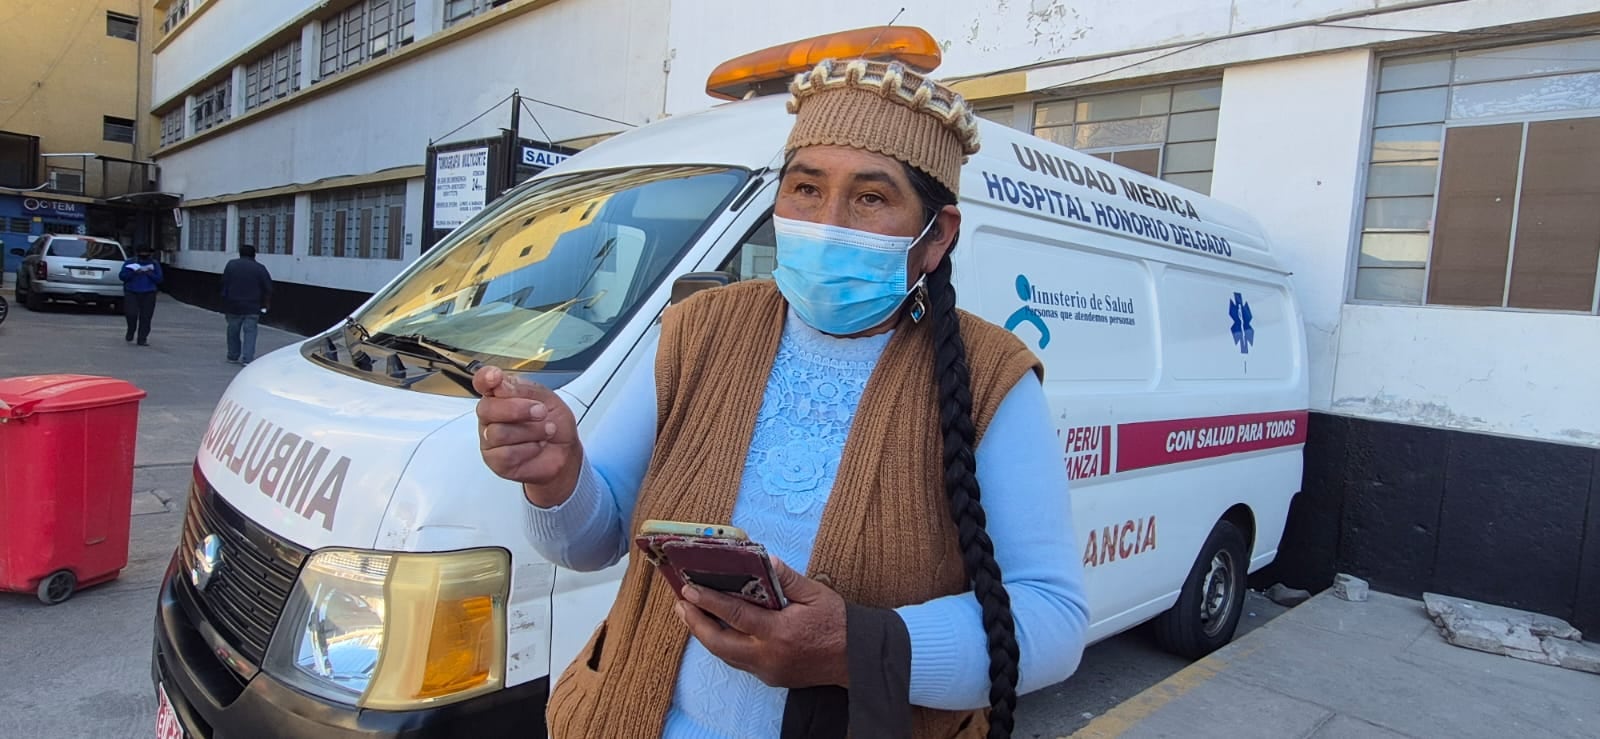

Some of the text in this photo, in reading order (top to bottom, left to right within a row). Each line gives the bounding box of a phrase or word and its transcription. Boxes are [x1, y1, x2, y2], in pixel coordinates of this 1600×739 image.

[1011, 143, 1201, 222] UNIDAD MEDICA
[982, 171, 1232, 257] HOSPITAL HONORIO DELGADO
[1024, 285, 1134, 314] Ministerio de Salud
[1025, 305, 1136, 326] Personas que atendemos personas
[1065, 426, 1101, 454] PERU
[1166, 419, 1296, 452] CON SALUD PARA TODOS
[1064, 454, 1099, 480] ANZA
[1083, 516, 1156, 568] ANCIA
